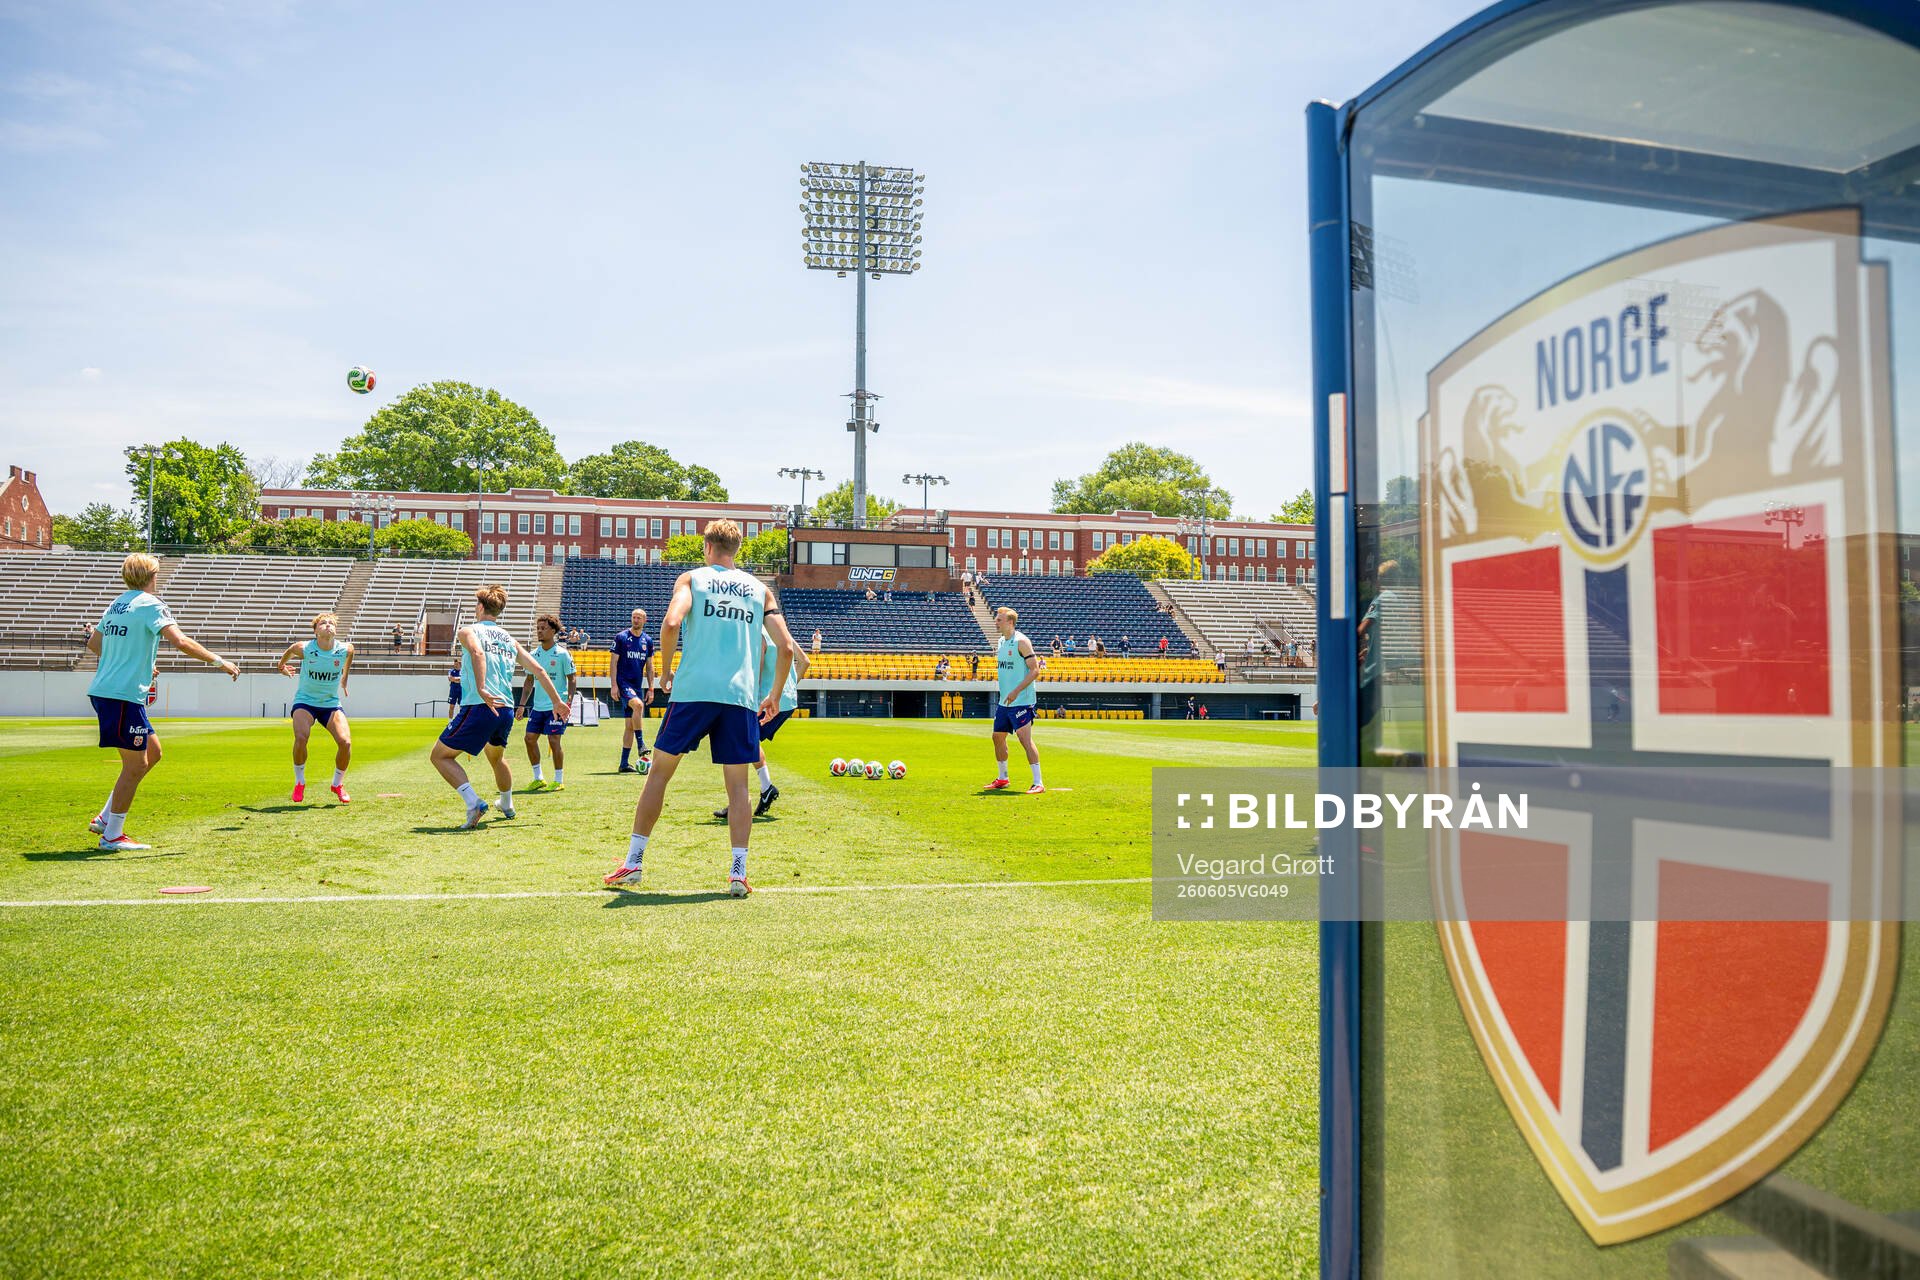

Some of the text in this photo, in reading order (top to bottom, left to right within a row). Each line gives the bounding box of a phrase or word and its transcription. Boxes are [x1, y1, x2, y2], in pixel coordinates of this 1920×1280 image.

[1535, 293, 1669, 410] NORGE
[1562, 421, 1645, 547] NFF
[850, 567, 895, 580] UNCG
[627, 651, 640, 659] KIWI
[309, 669, 331, 681] KIWI
